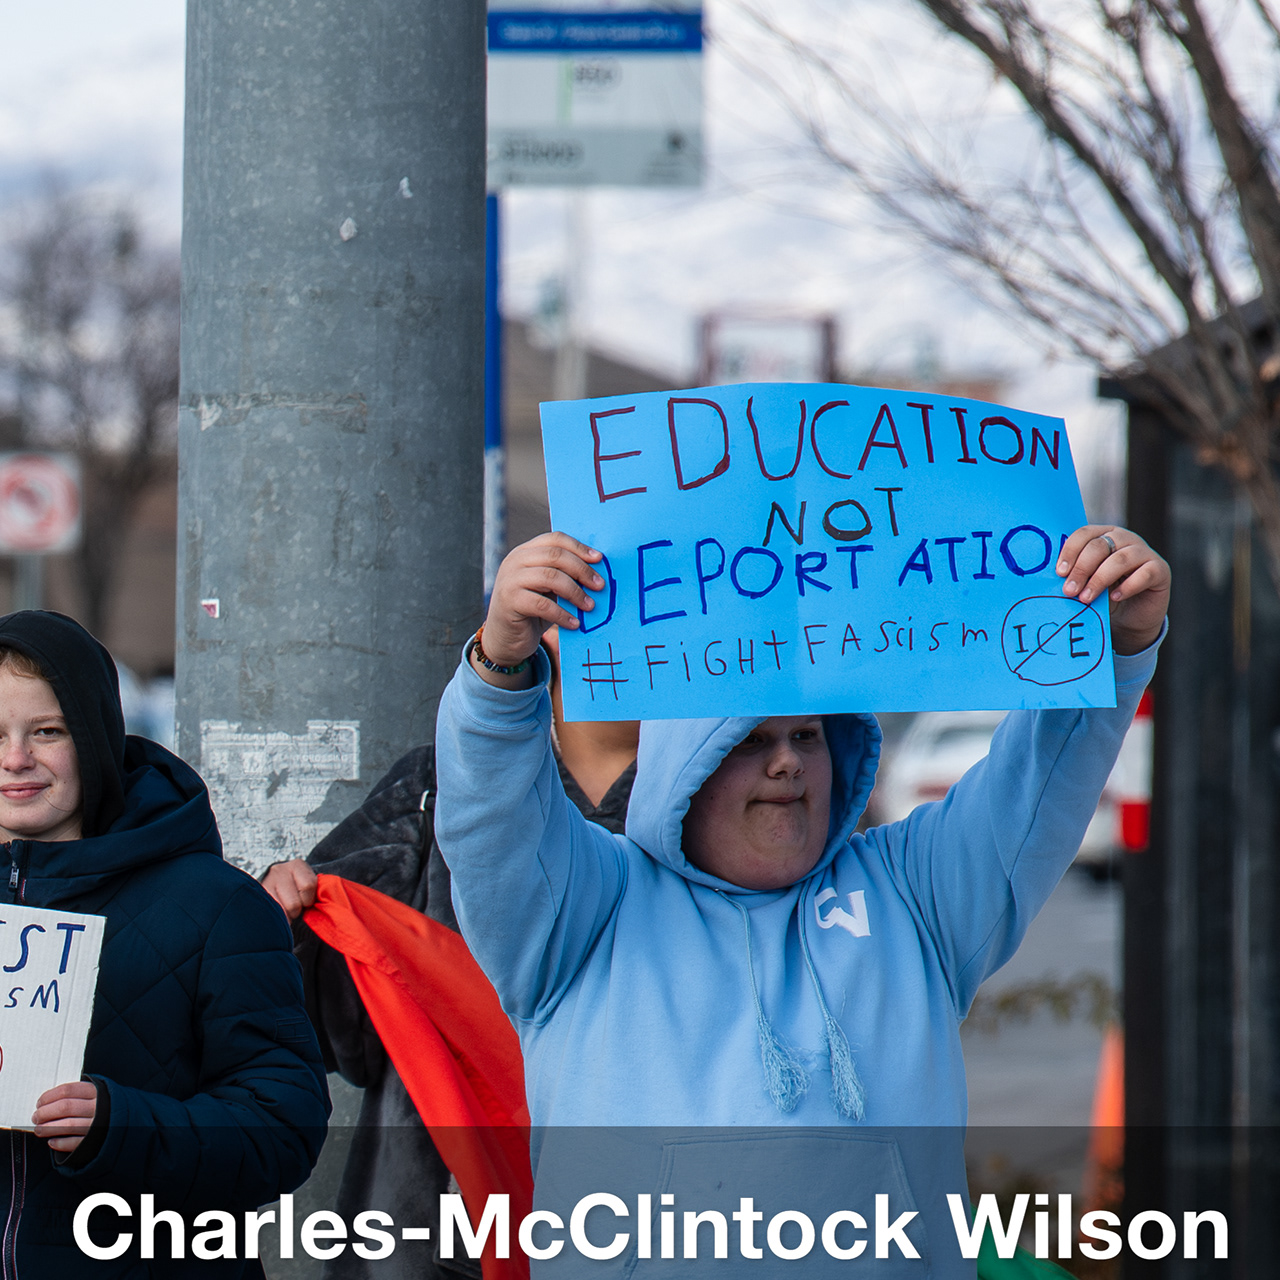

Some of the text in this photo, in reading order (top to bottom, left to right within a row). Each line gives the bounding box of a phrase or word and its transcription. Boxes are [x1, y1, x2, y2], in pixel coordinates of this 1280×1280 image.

[589, 395, 1062, 504] EDUCATION
[762, 486, 904, 546] NOT
[576, 524, 1068, 634] DEPORTATIO
[1012, 621, 1091, 658] ICE
